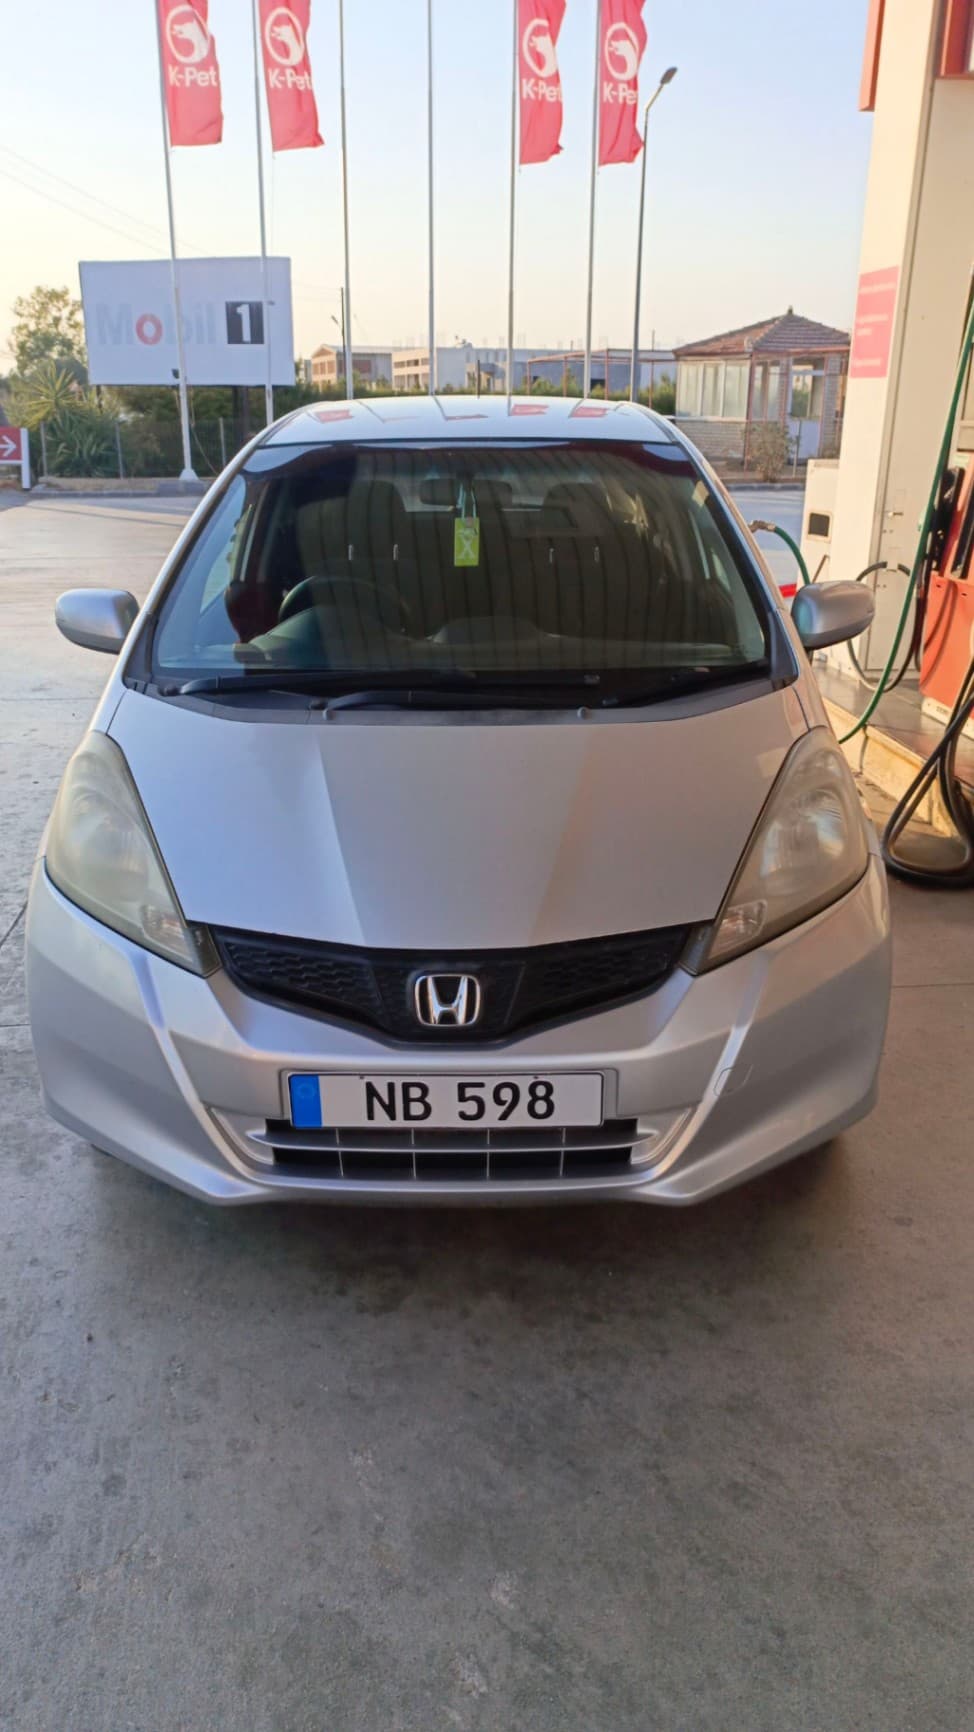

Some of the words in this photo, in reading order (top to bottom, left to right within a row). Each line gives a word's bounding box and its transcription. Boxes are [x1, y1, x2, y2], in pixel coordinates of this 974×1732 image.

[168, 65, 218, 87] K-Pet
[97, 303, 217, 345] Mobil
[236, 304, 252, 342] 1
[365, 1081, 432, 1121] NB
[456, 1080, 555, 1121] 598
